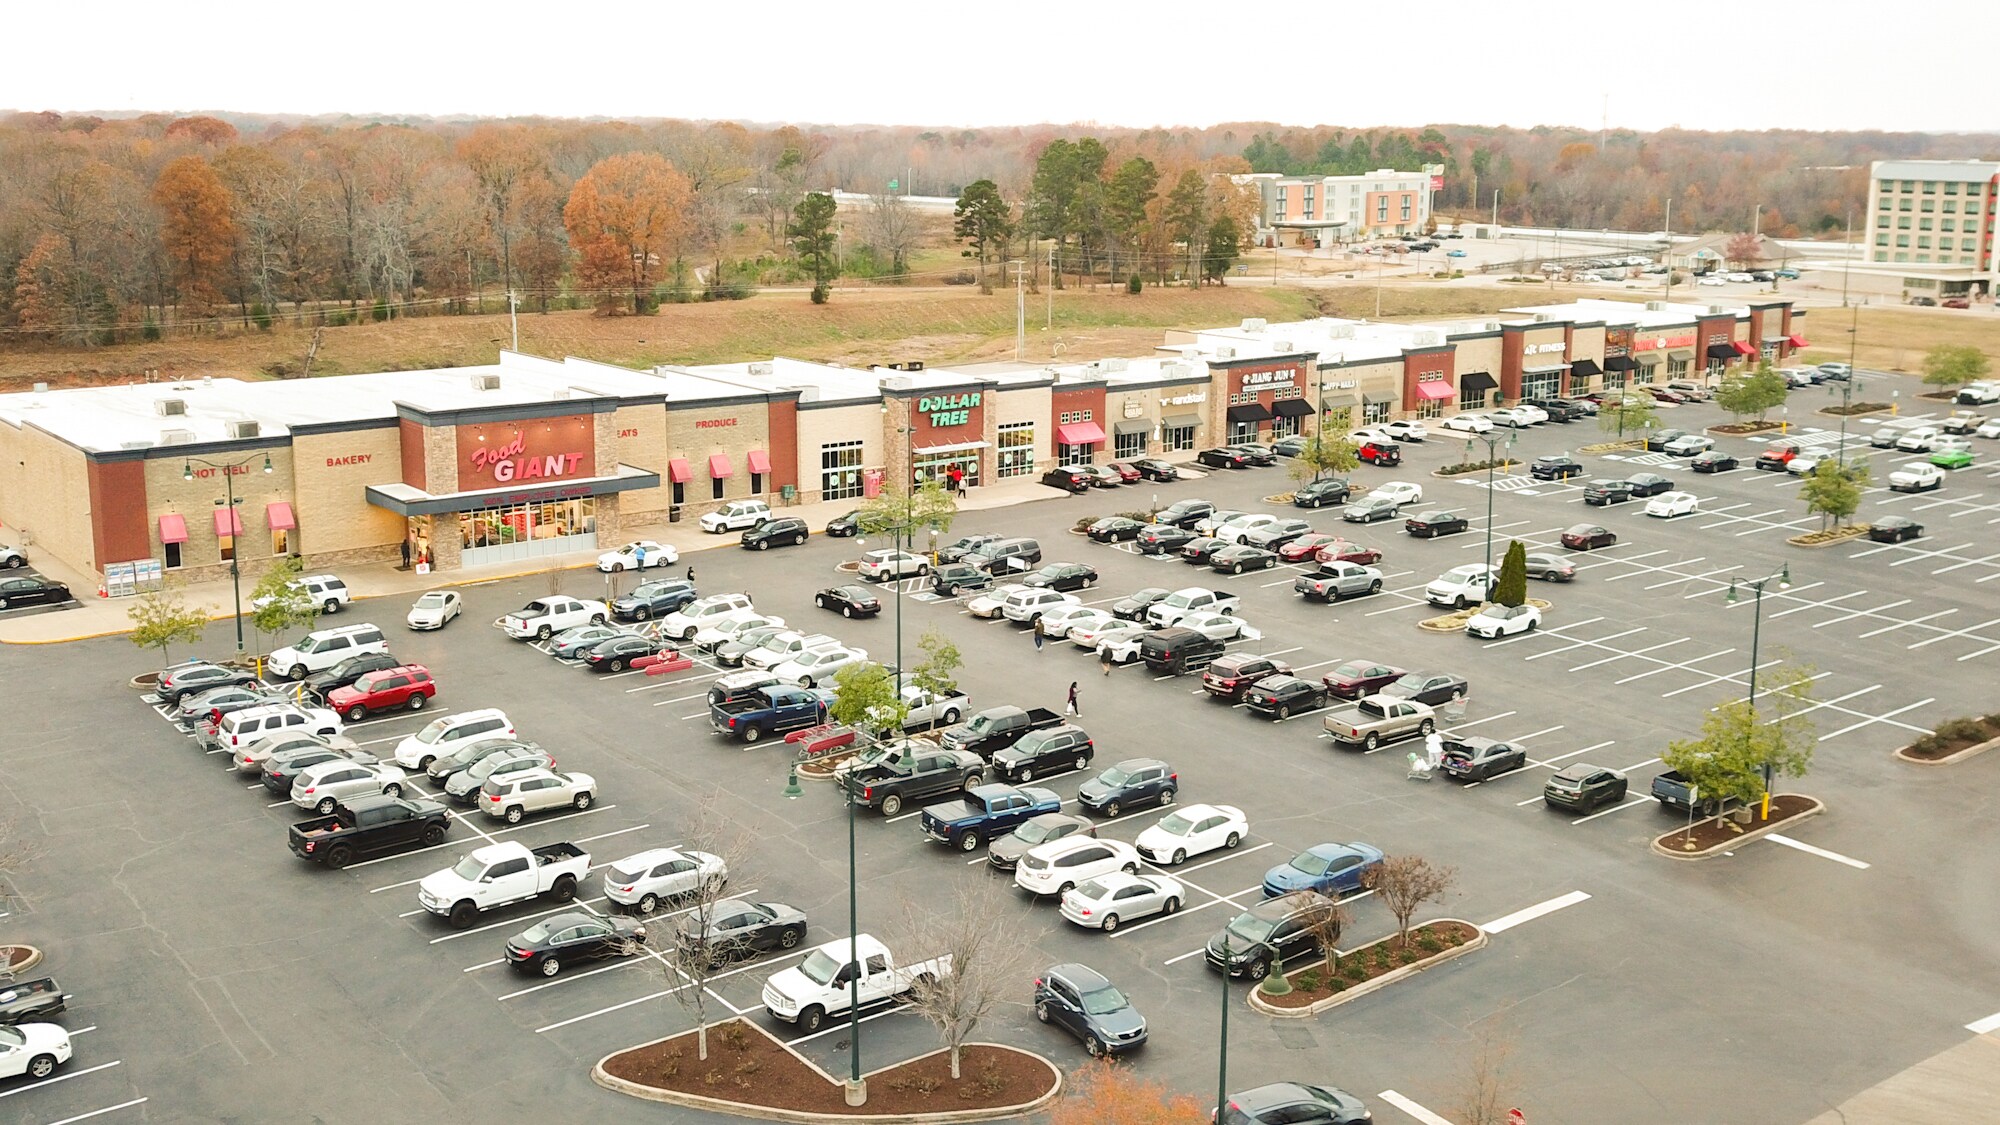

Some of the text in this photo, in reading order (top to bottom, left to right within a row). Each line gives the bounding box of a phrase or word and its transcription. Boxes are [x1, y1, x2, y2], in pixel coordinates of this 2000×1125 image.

[1539, 342, 1566, 353] FITNESS
[1250, 370, 1289, 383] JIANG JUN
[919, 393, 981, 412] DOLLAR
[1172, 391, 1206, 405] randstad
[695, 418, 738, 429] PRODUCE
[930, 410, 969, 428] TREE
[616, 428, 638, 439] EATS
[471, 430, 526, 473] Food
[326, 454, 372, 467] BAKERY
[494, 452, 584, 482] GIANT
[222, 465, 250, 476] DELI
[560, 486, 592, 497] OWNED
[1508, 1113, 1526, 1125] STOP
